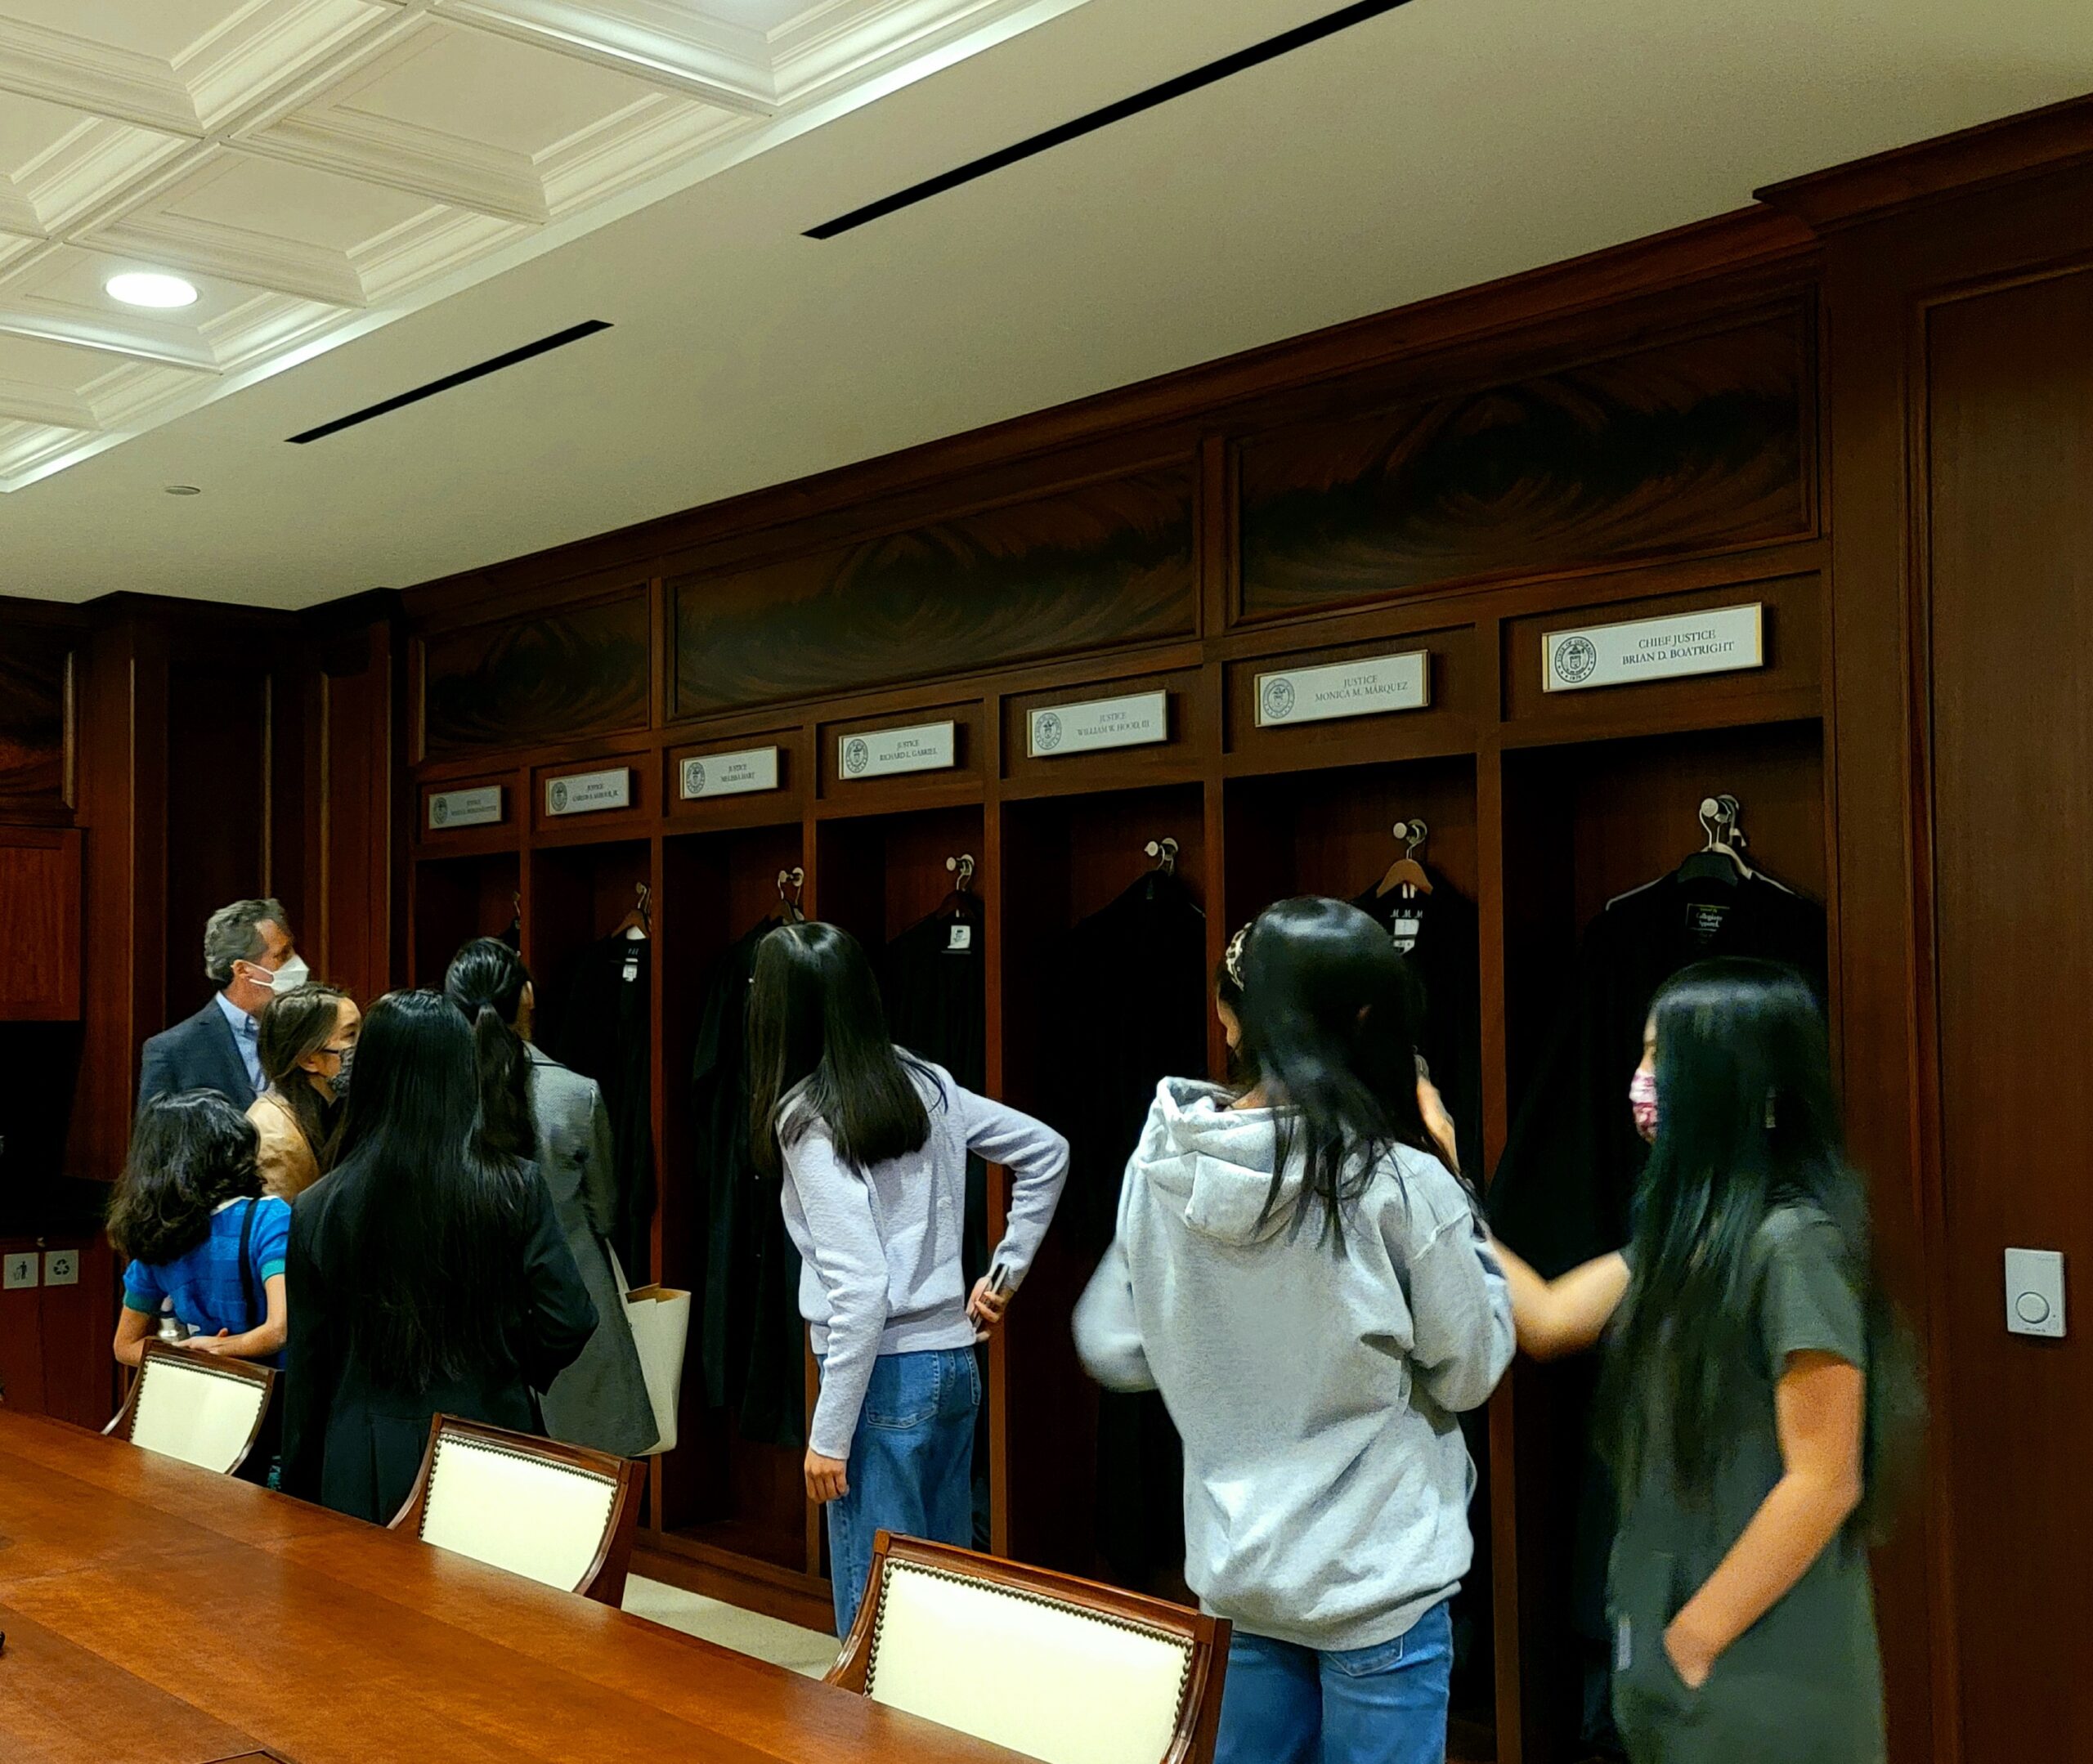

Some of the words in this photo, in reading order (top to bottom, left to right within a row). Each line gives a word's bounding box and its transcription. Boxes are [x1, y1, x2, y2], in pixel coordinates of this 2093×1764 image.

[1638, 633, 1671, 649] CHIEF
[1673, 629, 1716, 646] JUSTICE
[1622, 651, 1655, 665] BRIAN
[1657, 649, 1668, 660] D.
[1669, 641, 1735, 660] BOATRIGHT
[1343, 674, 1378, 688] JUSTICE
[1315, 689, 1350, 702] MONICA
[1099, 712, 1127, 723] JUSTICE
